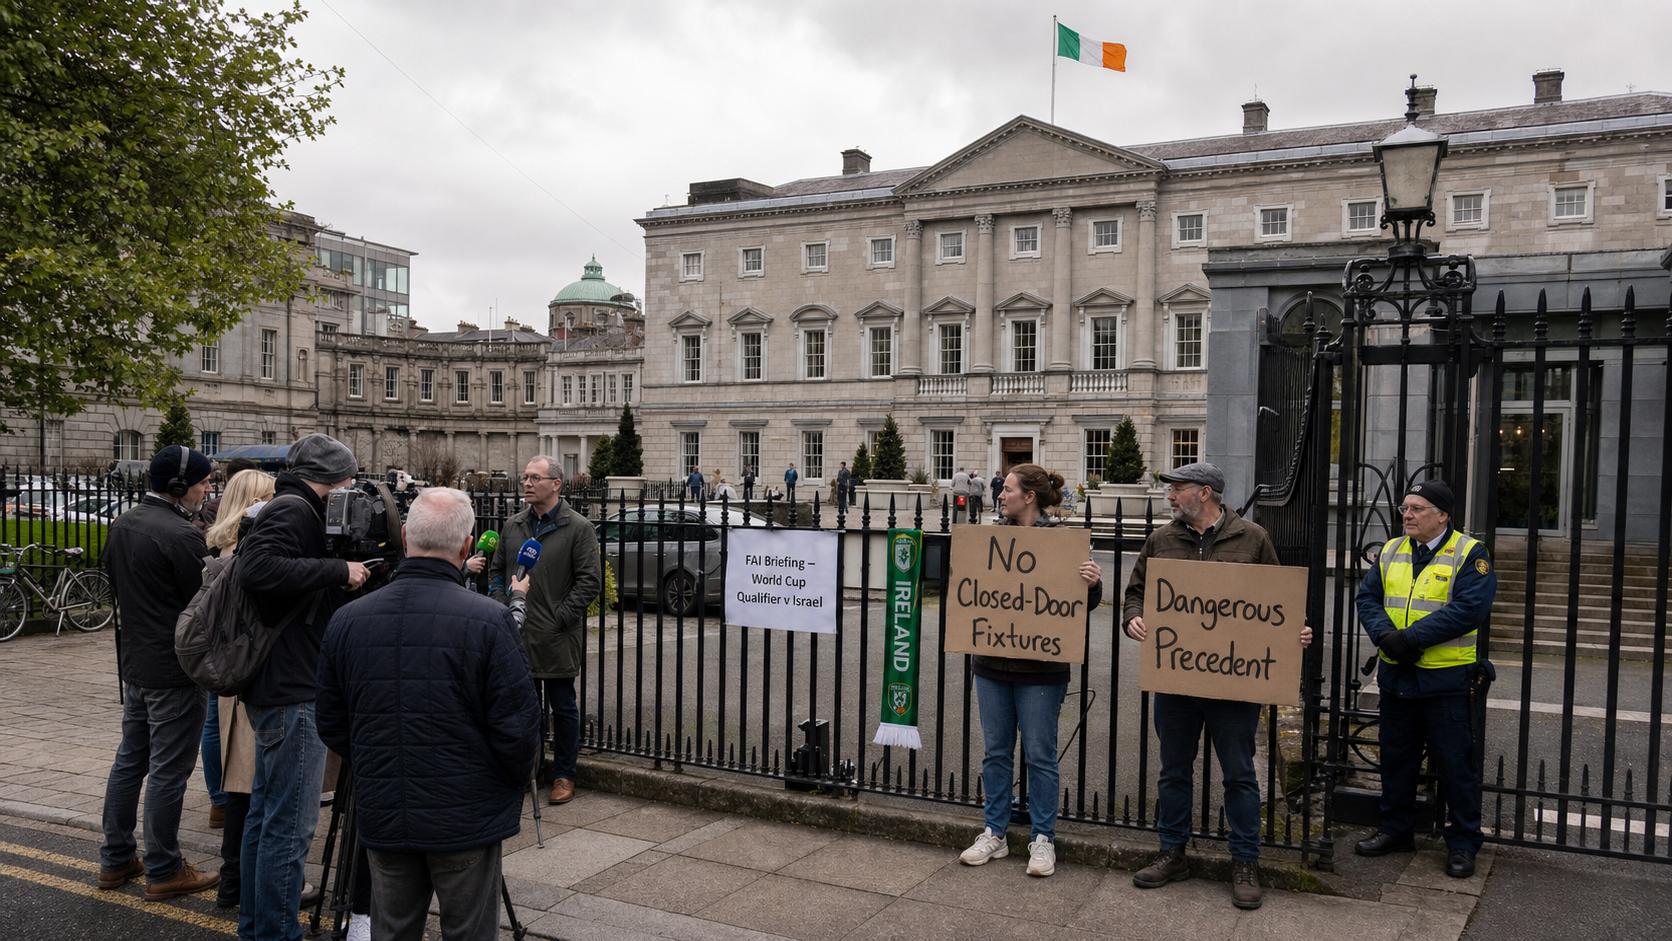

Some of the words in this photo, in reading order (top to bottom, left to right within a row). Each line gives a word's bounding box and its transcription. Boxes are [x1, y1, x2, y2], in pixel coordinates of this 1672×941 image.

[745, 555, 762, 566] FAI
[764, 556, 805, 571] Briefing
[988, 535, 1036, 574] No
[736, 591, 781, 605] Qualifier
[783, 597, 790, 605] v
[793, 595, 823, 608] Israel
[751, 574, 782, 586] World
[785, 576, 806, 590] Cup
[957, 577, 1084, 618] Closed-Door
[1156, 578, 1285, 631] Dangerous
[893, 581, 912, 673] IRELAND
[972, 617, 1061, 656] Fixtures
[1155, 626, 1277, 681] Precedent
